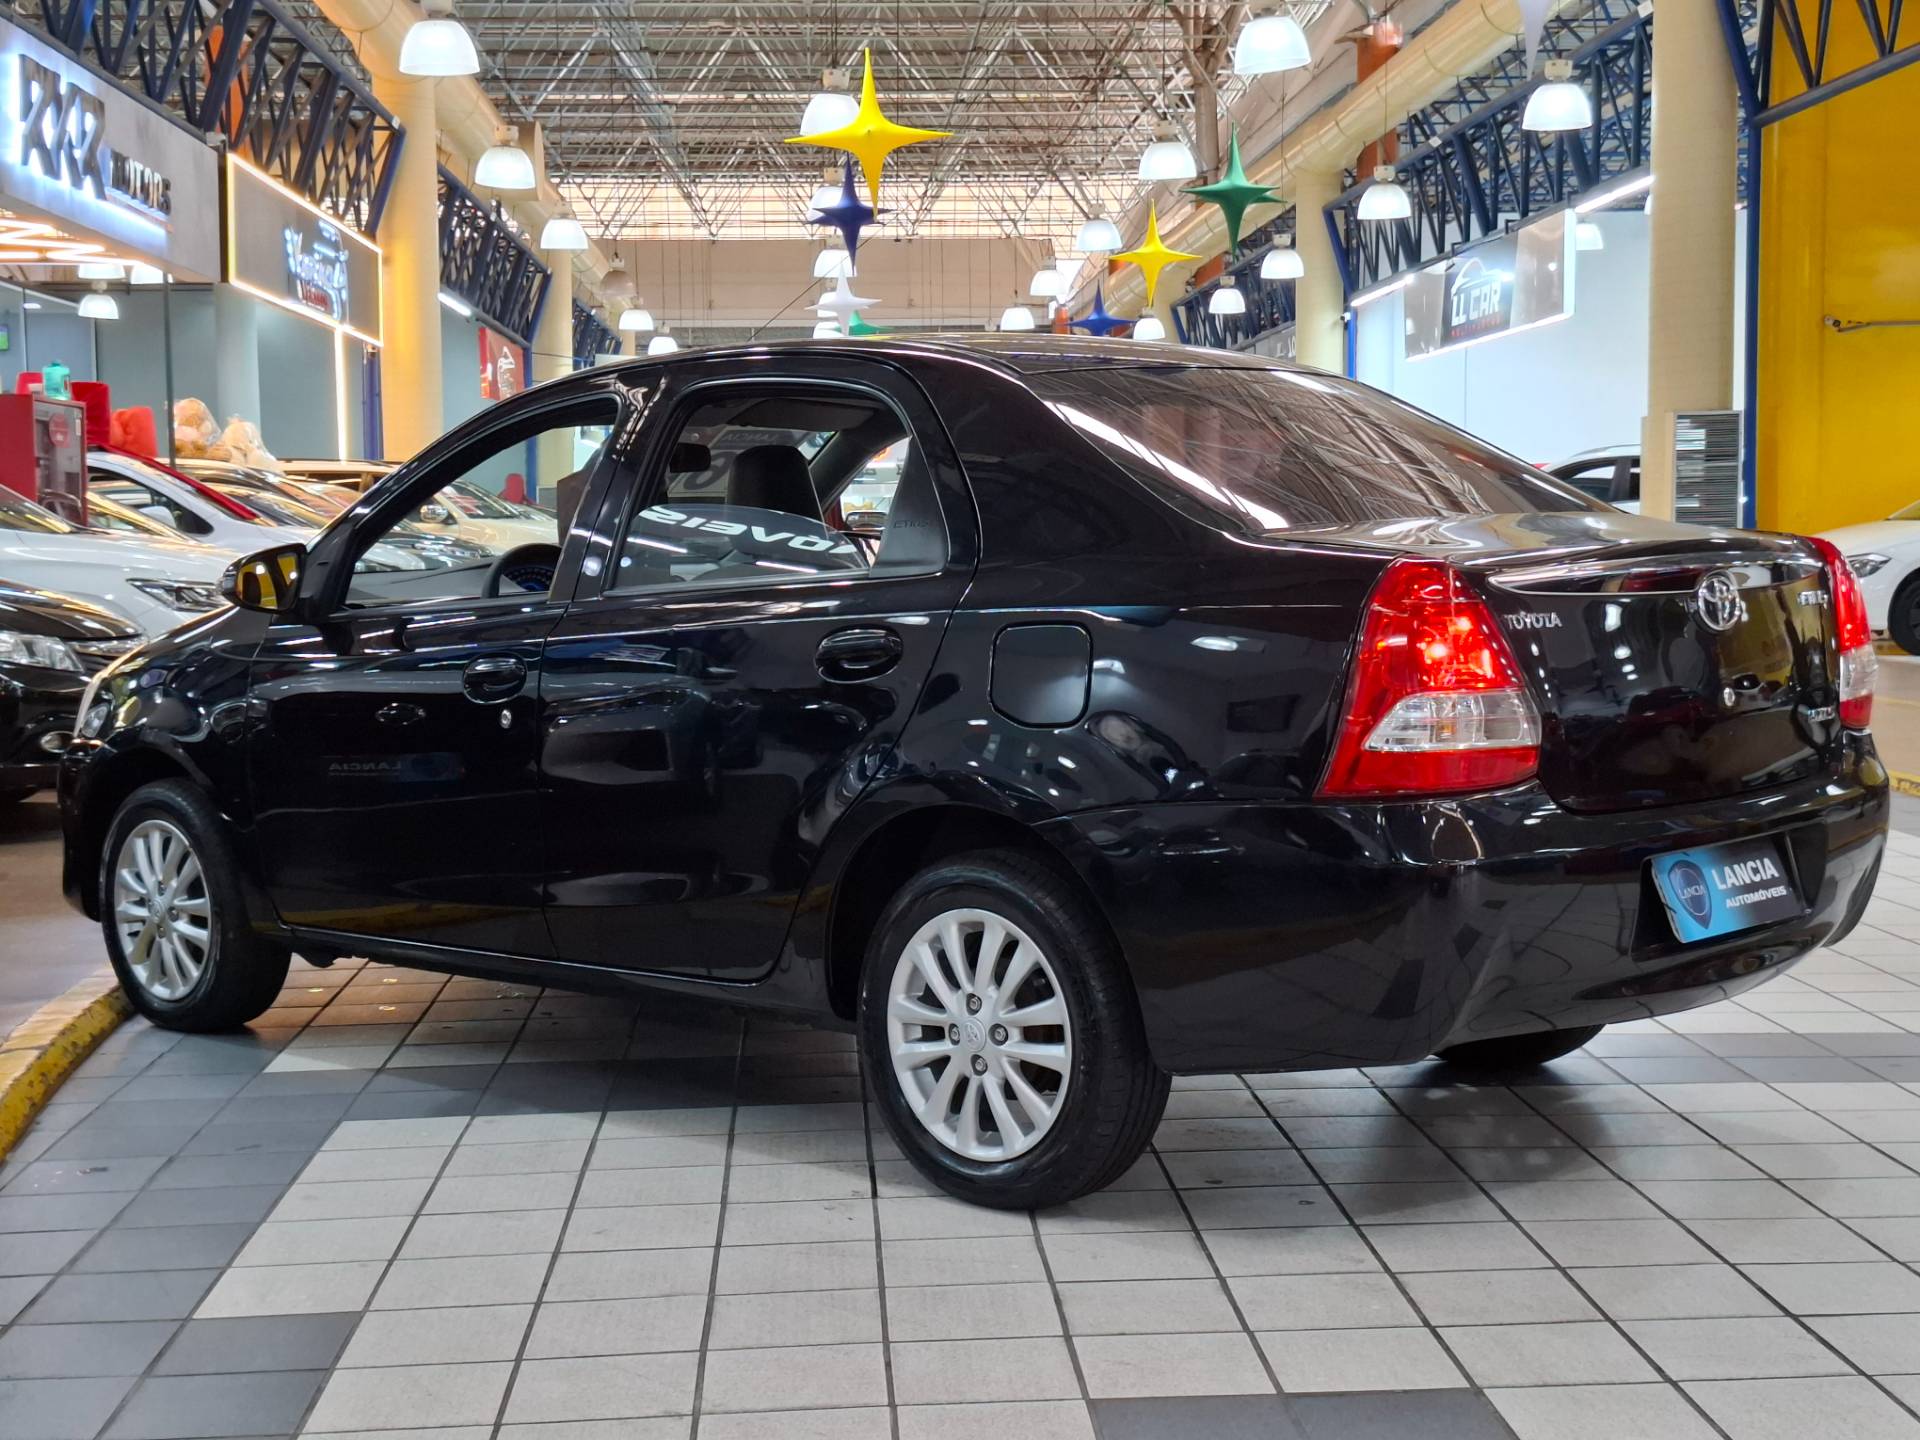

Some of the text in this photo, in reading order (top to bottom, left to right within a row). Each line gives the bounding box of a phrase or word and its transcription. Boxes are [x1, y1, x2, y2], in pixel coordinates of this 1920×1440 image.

[110, 147, 172, 216] MOTORS
[1469, 281, 1502, 321] CAR
[1503, 610, 1563, 630] TOYOTA
[1711, 857, 1780, 891] LANCIA
[1726, 885, 1788, 909] AUTOMÓVEIS
